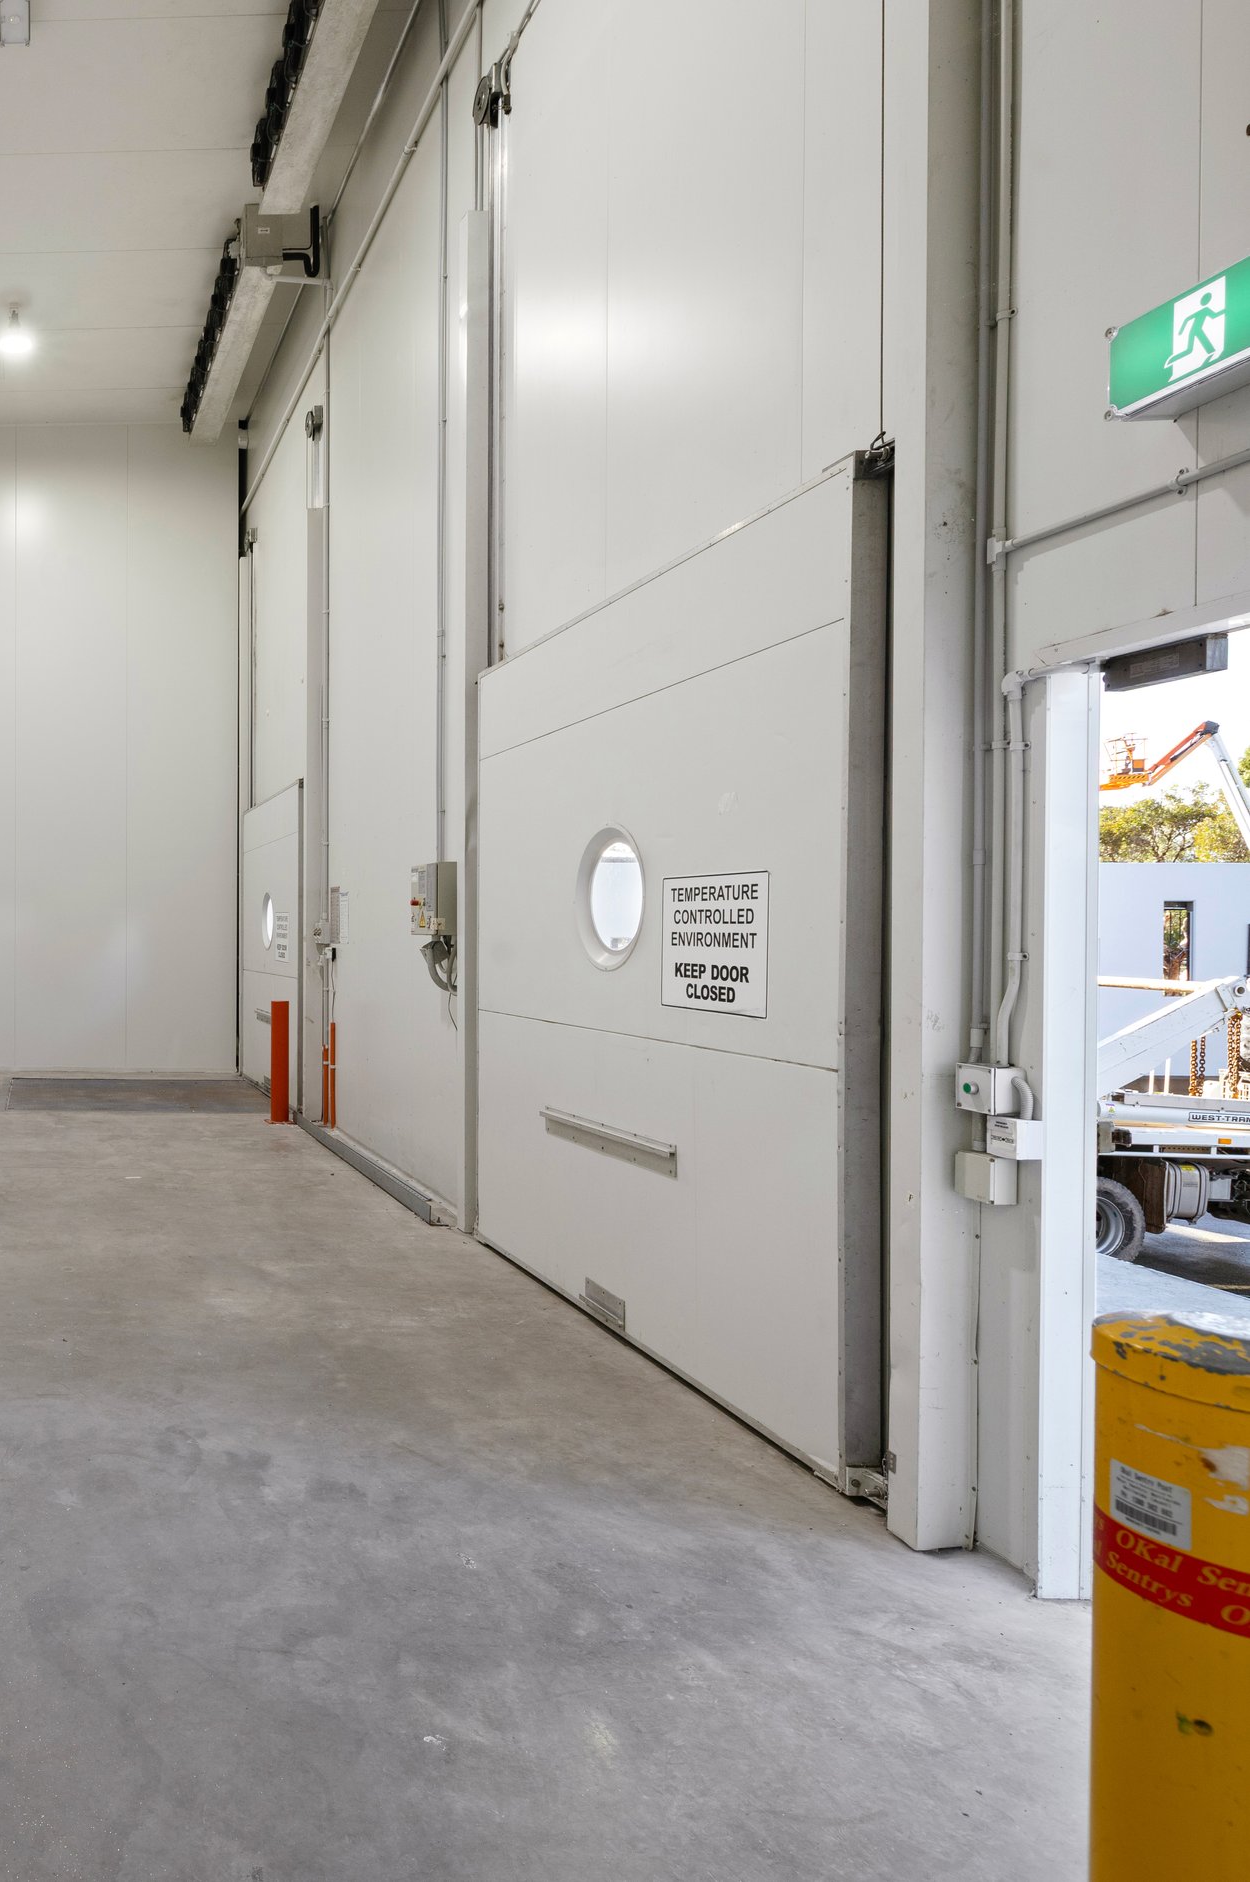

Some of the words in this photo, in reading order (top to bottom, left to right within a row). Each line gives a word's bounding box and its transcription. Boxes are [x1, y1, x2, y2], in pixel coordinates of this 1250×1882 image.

[670, 883, 759, 903] TEMPERATURE
[673, 908, 755, 925] CONTROLLED
[671, 931, 757, 949] ENVIRONMENT
[674, 962, 707, 980] KEEP
[710, 964, 750, 984] DOOR
[685, 983, 736, 1004] CLOSED
[1115, 1529, 1183, 1573] OKal
[1105, 1551, 1194, 1608] Sentrys
